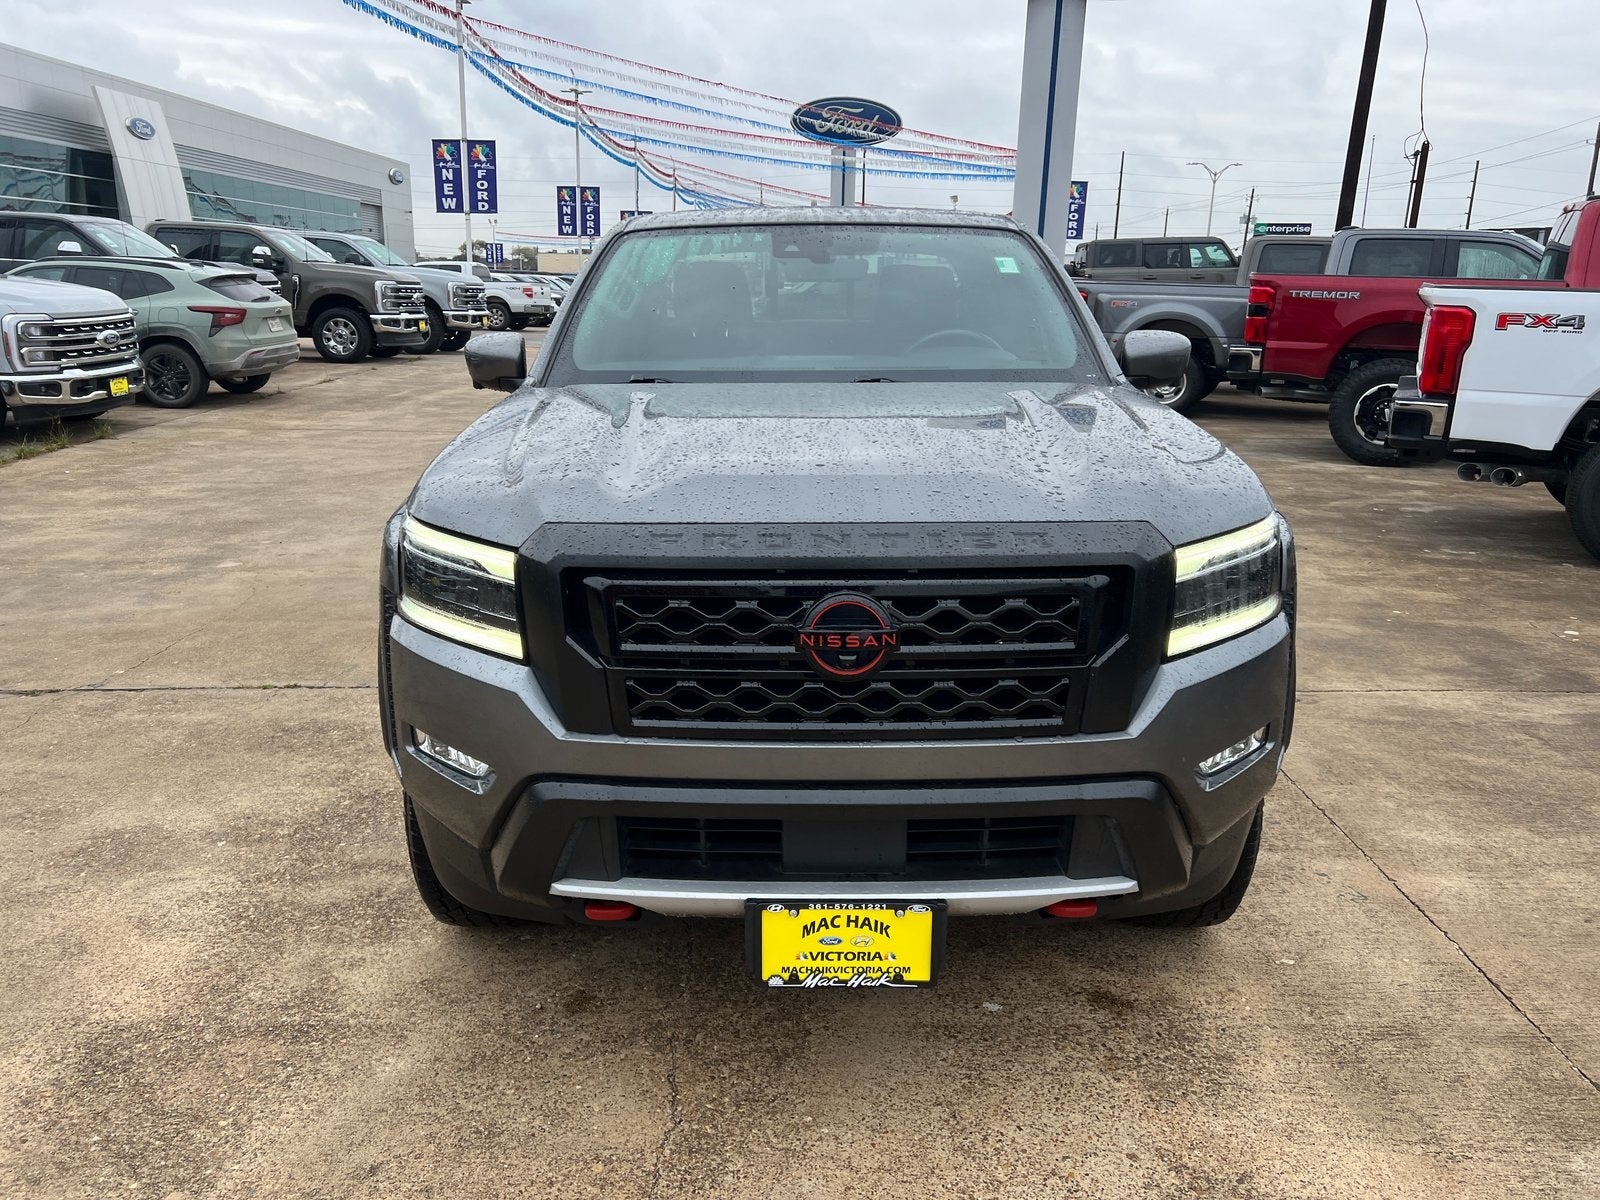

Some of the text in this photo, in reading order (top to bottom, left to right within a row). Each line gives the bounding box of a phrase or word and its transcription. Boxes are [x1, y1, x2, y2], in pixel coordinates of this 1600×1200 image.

[814, 105, 888, 134] Ford
[441, 168, 456, 209] NEW
[476, 169, 489, 211] FORD
[562, 205, 573, 234] NEW
[586, 206, 595, 235] FORD
[1067, 204, 1079, 237] FORD
[1256, 224, 1311, 234] enterprise
[1289, 290, 1361, 299] TREMOR
[1495, 312, 1585, 331] FX4
[649, 531, 1054, 551] FRONTIER
[800, 632, 898, 649] NISSAN
[802, 914, 891, 939] MAC HAIK
[809, 951, 884, 962] VICTORIA
[781, 966, 911, 975] MACHAIKVICTORIA.COM
[801, 972, 900, 988] Mac Haik
